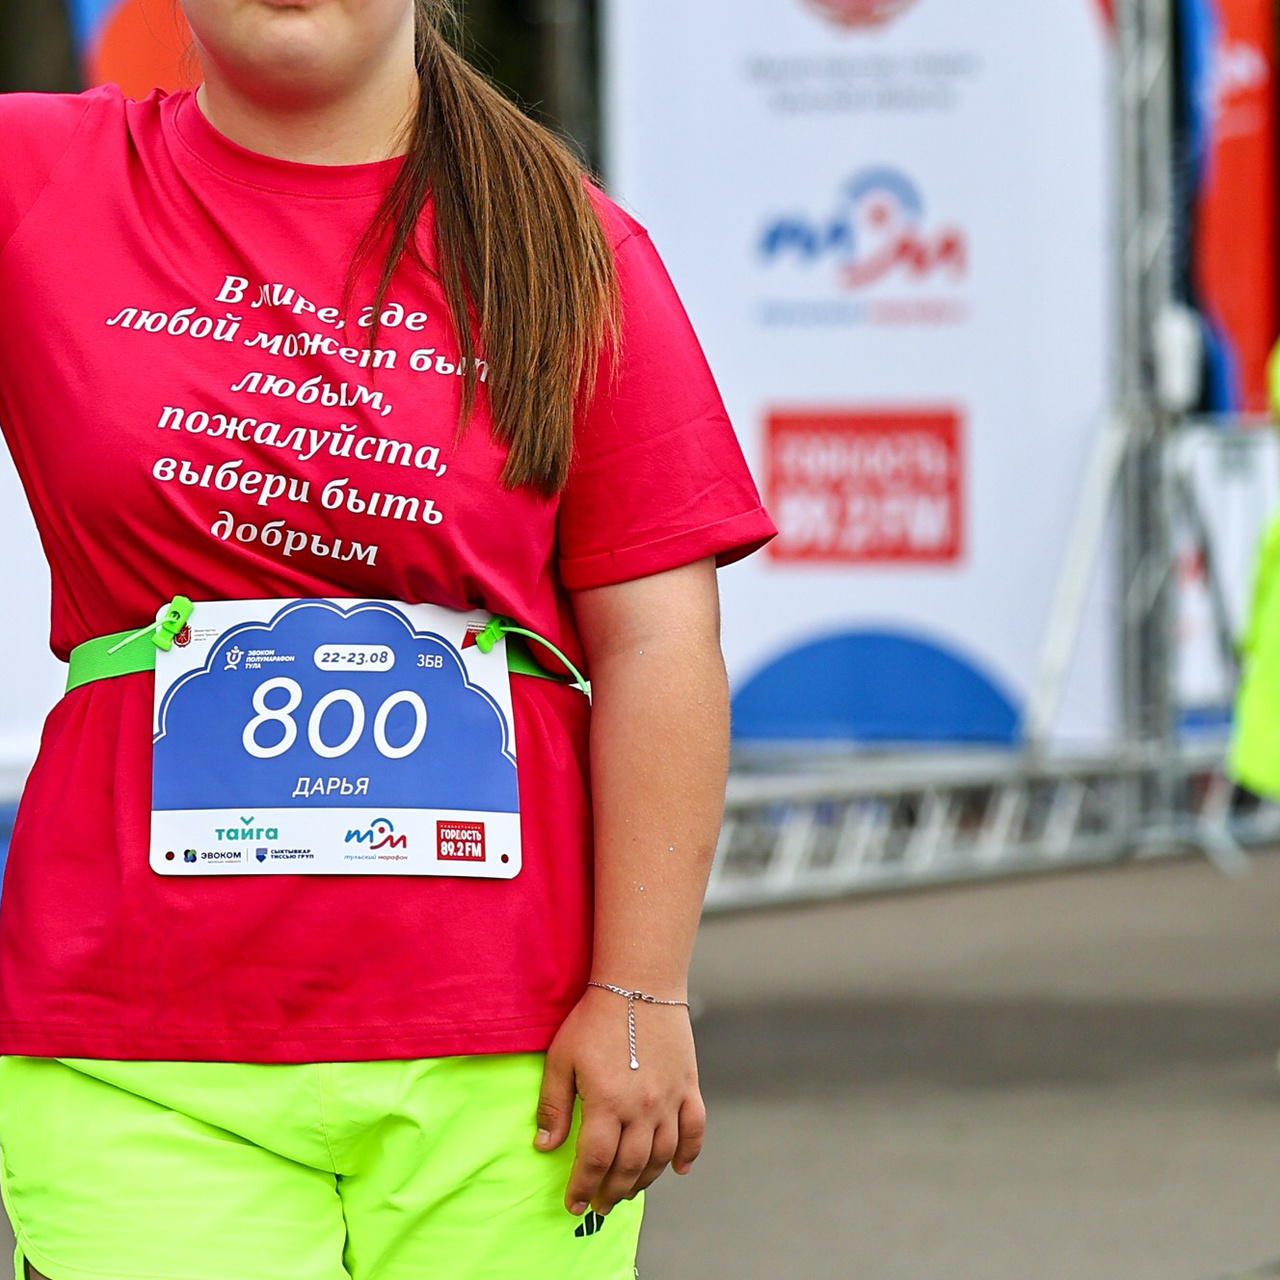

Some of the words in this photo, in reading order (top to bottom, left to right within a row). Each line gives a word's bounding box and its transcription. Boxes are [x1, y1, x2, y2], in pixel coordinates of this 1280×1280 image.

[215, 275, 249, 305] В
[251, 283, 345, 330] мире,
[358, 303, 428, 331] где
[106, 307, 242, 343] любой
[244, 331, 396, 369] может
[231, 368, 393, 416] любым,
[158, 405, 450, 478] пожалуйста,
[152, 456, 310, 506] выбери
[320, 478, 444, 525] быть
[210, 511, 378, 566] добрым
[245, 655, 295, 663] ПОЛУМАРАФОН
[320, 650, 389, 666] 22-23.08
[242, 677, 427, 759] 800
[292, 777, 370, 798] ДАРЬЯ
[215, 816, 278, 841] тайга
[440, 841, 464, 857] 89.2
[465, 842, 482, 857] FM
[201, 851, 242, 860] ЭВОКОМ
